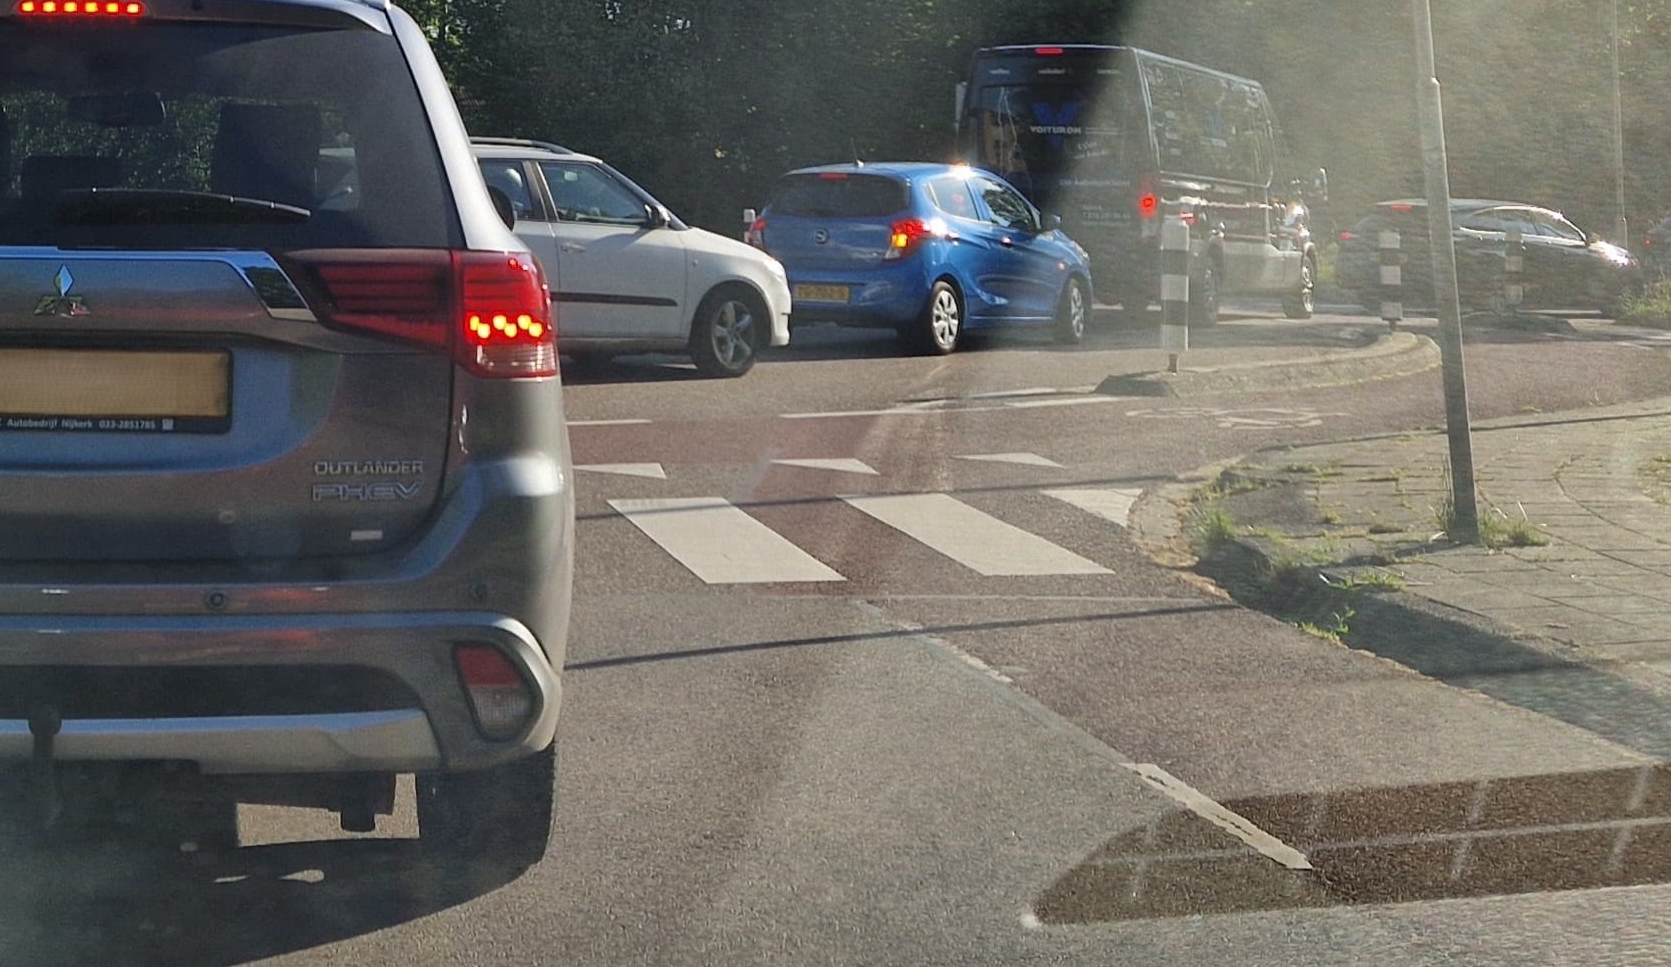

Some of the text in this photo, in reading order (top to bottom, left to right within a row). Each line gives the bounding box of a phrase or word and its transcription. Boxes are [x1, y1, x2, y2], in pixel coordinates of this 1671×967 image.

[7, 418, 58, 430] Autobedrijf
[61, 418, 93, 430] Nijkerk
[314, 460, 424, 475] OUTLANDER
[312, 480, 425, 501] PHEV
